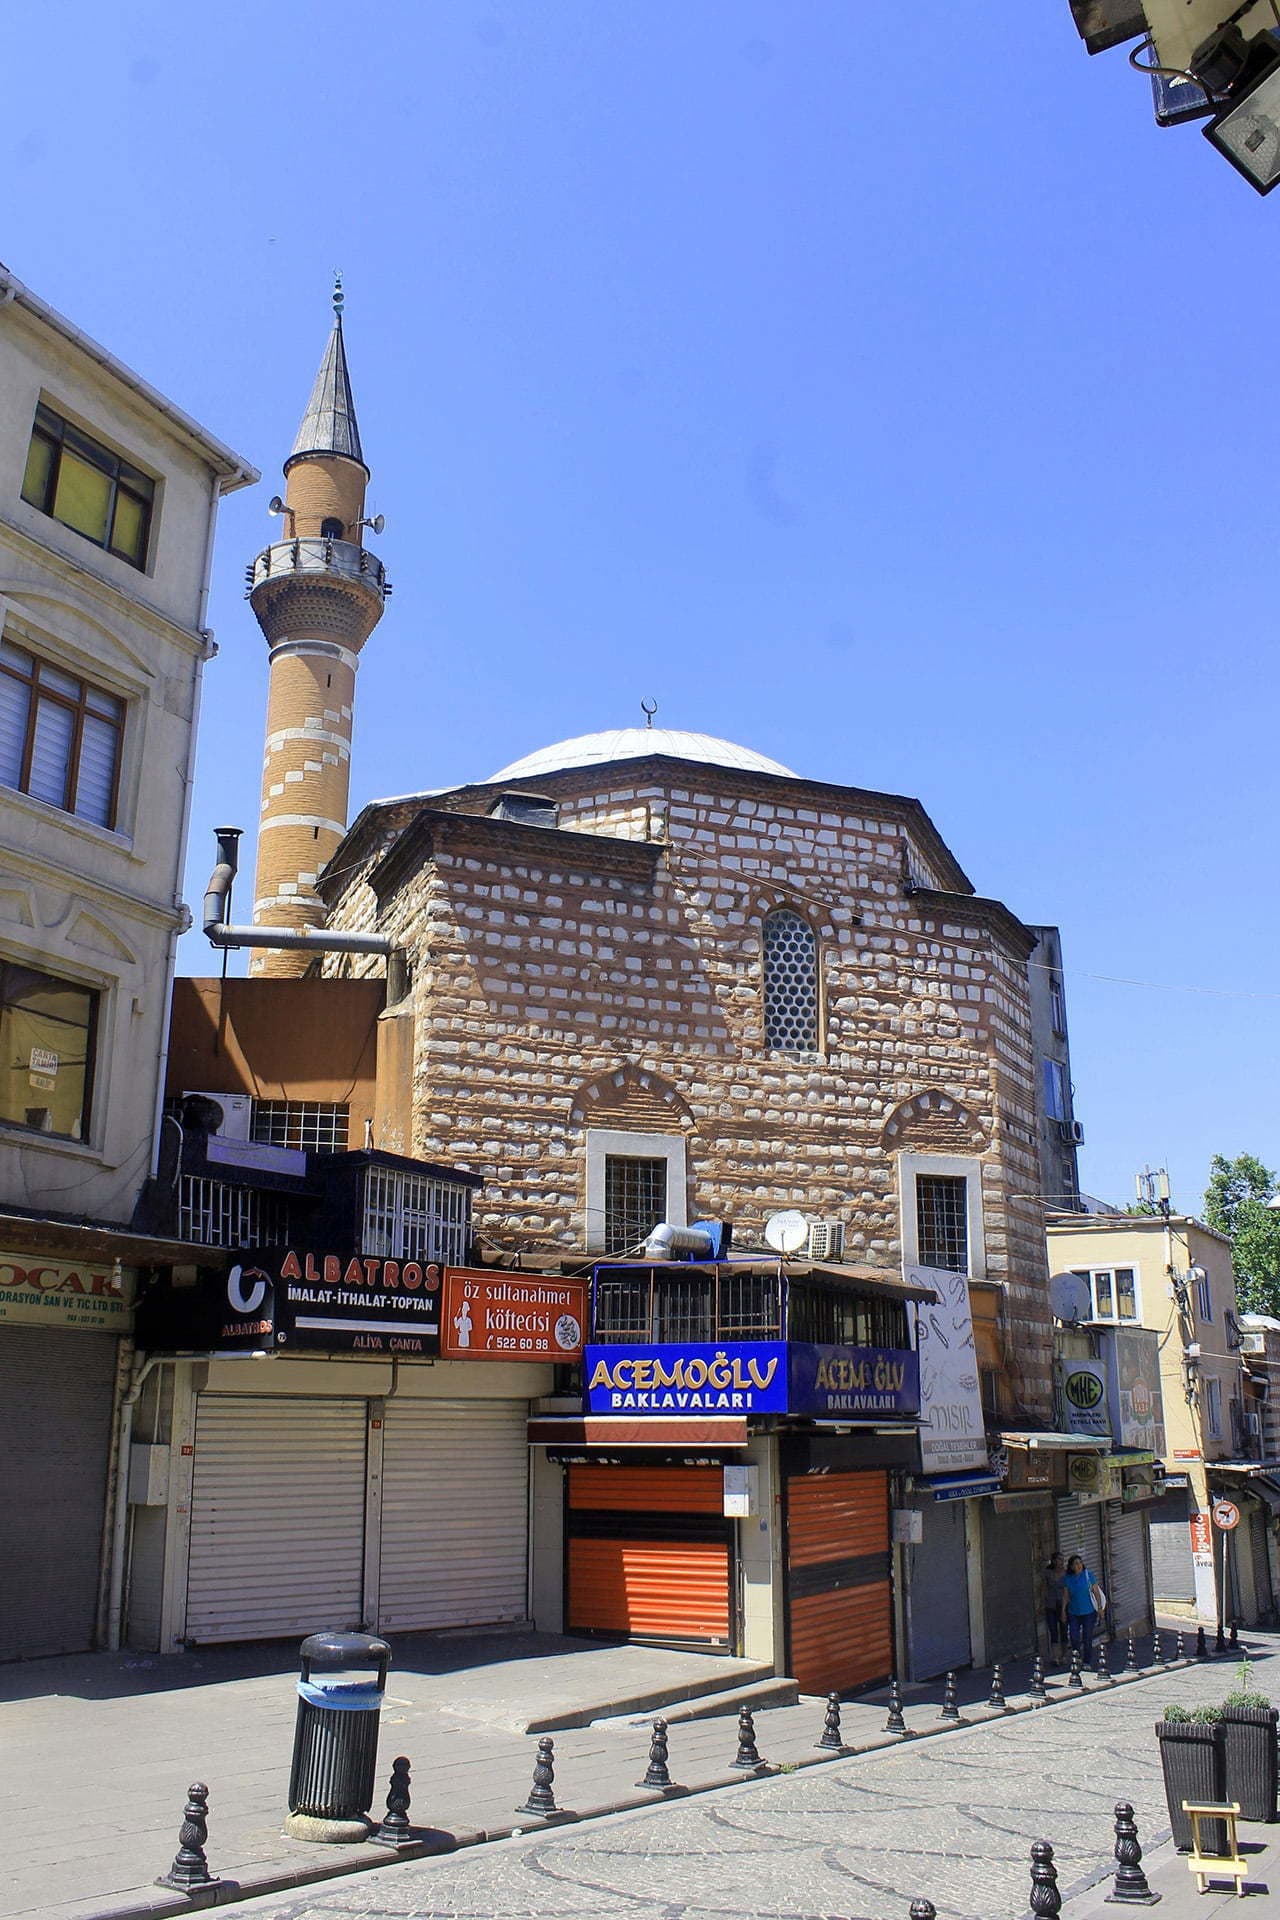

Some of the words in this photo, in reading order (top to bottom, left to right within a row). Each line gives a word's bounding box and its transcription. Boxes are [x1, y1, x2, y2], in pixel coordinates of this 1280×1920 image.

[280, 1252, 440, 1291] ALBATROS
[44, 1295, 60, 1306] SAN
[64, 1296, 74, 1308] VE
[464, 1281, 480, 1299] öz
[486, 1283, 571, 1305] sultanahmet
[222, 1320, 273, 1336] ALBATROS
[486, 1308, 550, 1332] köftecisi
[353, 1333, 382, 1349] ALİYA
[389, 1338, 422, 1351] ÇANTA
[496, 1337, 517, 1349] 522
[520, 1339, 532, 1350] 60
[536, 1339, 549, 1350] 98
[589, 1351, 778, 1390] ACEMOĞLU
[1070, 1376, 1098, 1405] MKE
[611, 1393, 753, 1408] BAKLAVALARI
[827, 1394, 896, 1410] BAKLAVALARI
